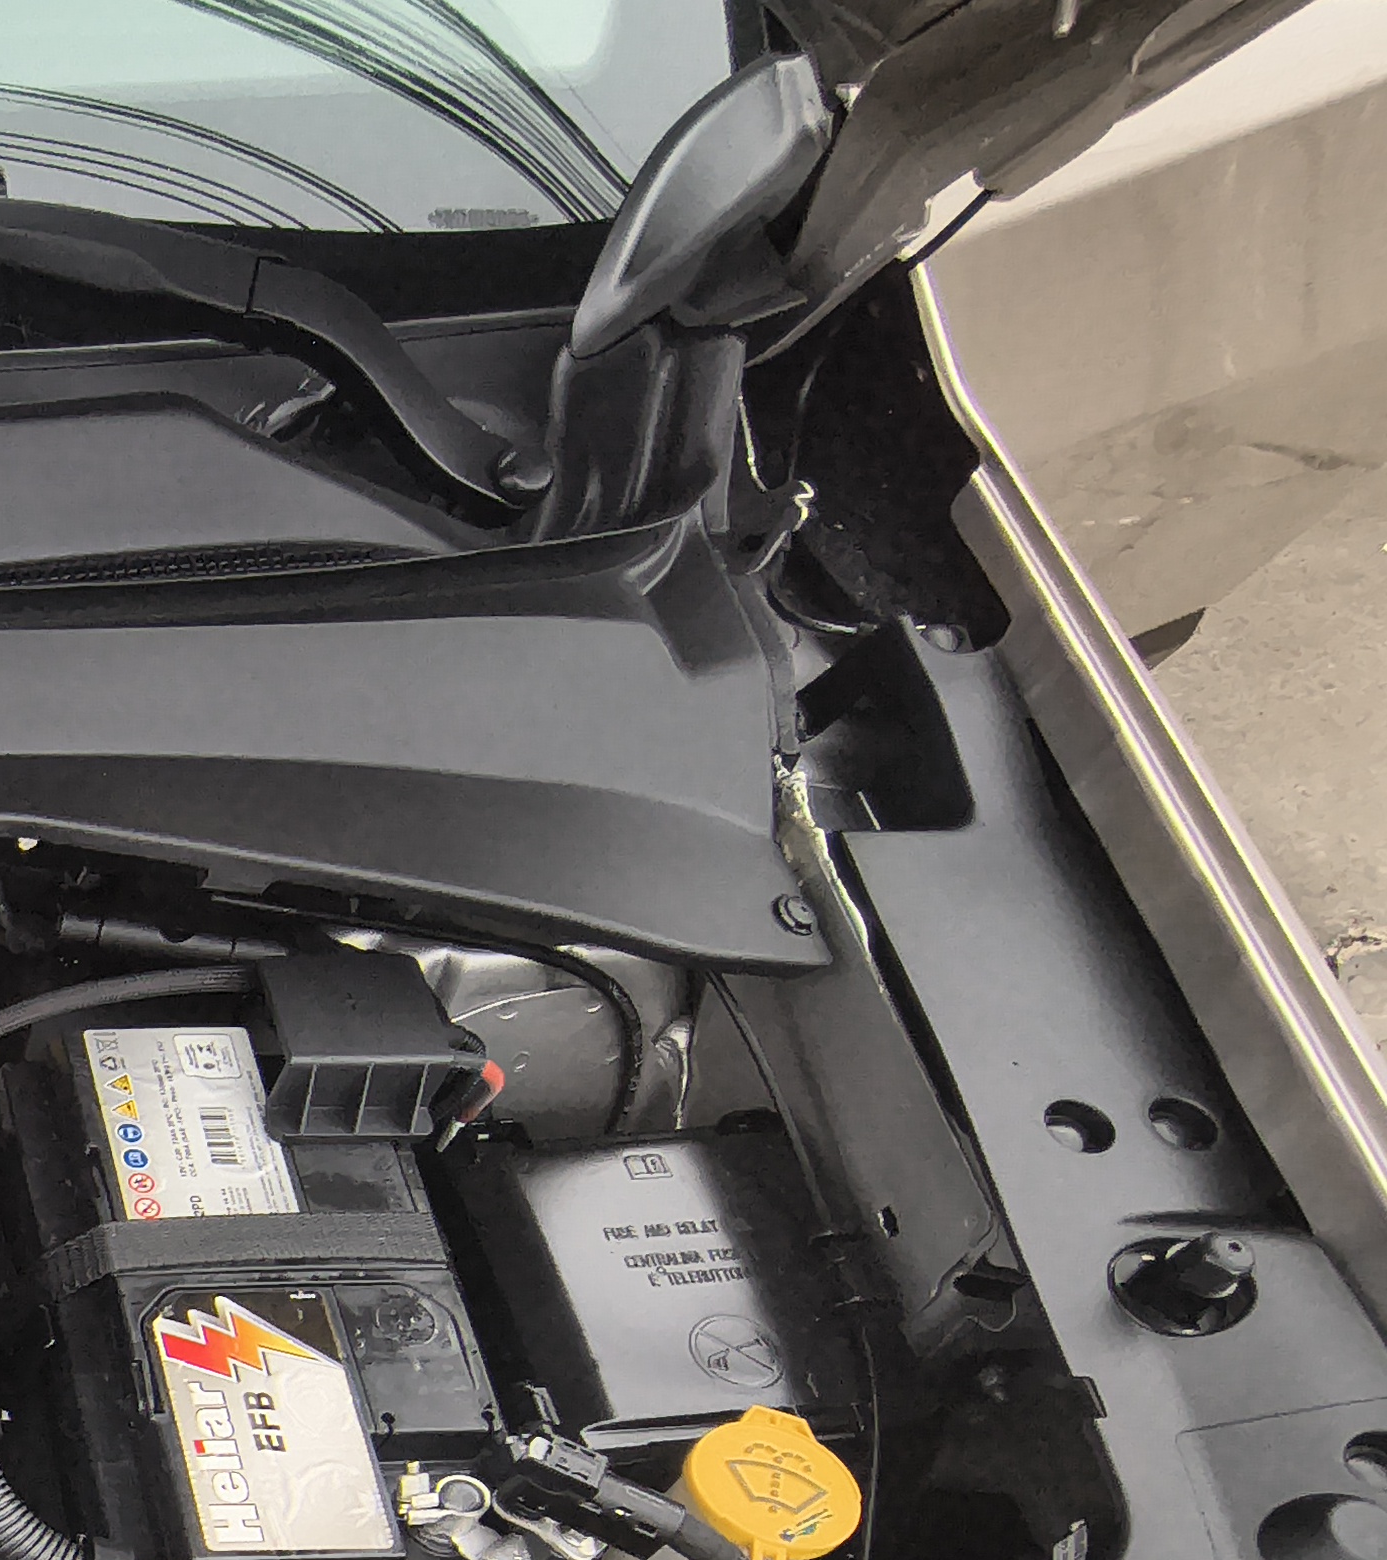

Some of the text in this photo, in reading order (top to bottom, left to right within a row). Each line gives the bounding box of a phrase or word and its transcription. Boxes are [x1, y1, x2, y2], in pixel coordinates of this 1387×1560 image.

[603, 1225, 639, 1242] FUSE
[243, 1391, 287, 1452] EFB
[183, 1378, 265, 1543] Heliar
